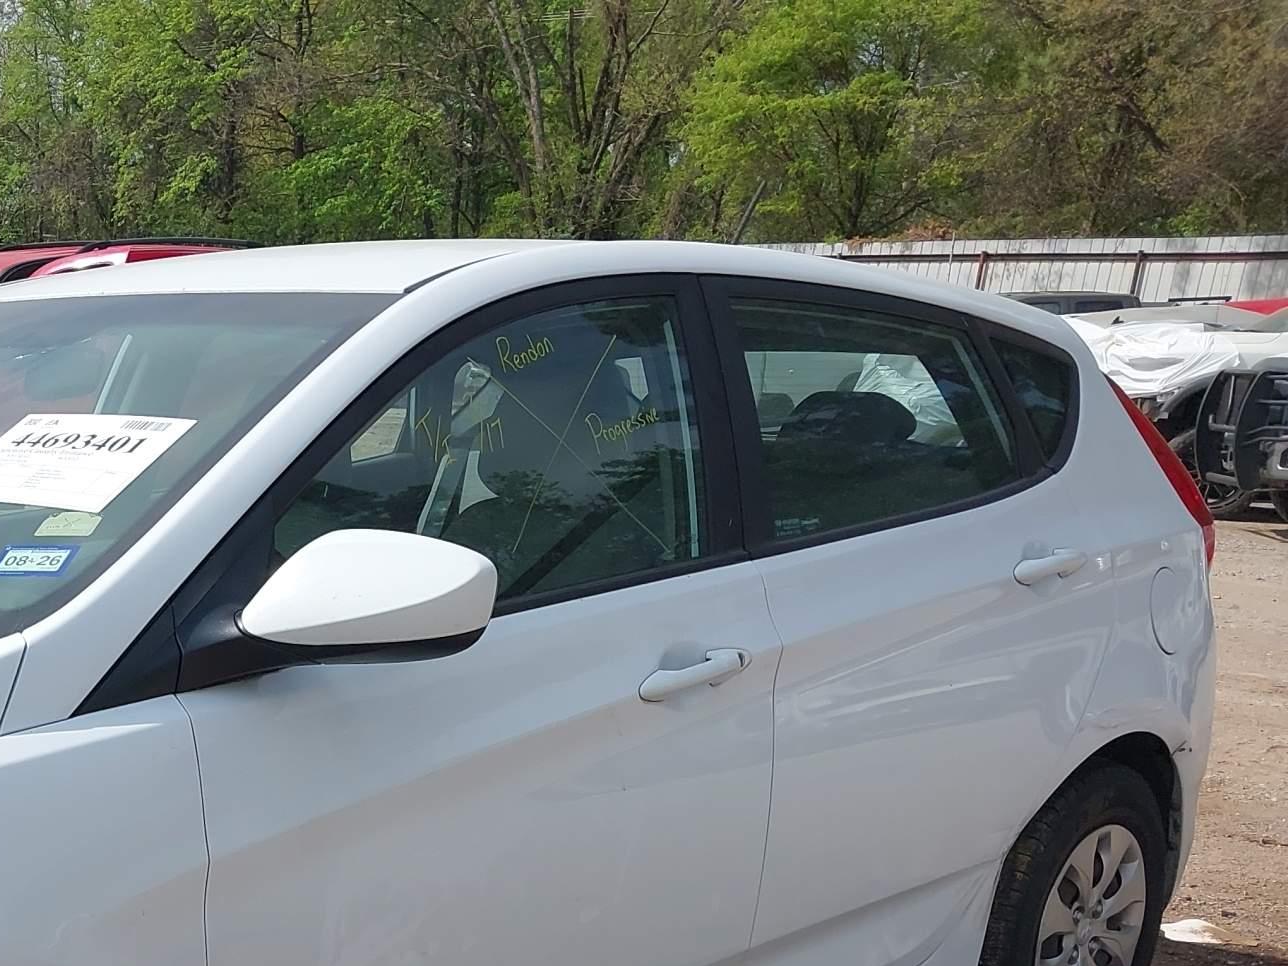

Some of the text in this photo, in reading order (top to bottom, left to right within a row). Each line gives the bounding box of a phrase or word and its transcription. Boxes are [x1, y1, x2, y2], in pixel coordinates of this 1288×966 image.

[495, 334, 554, 373] Rendon
[12, 432, 147, 453] 44693401
[584, 406, 661, 455] Progressive
